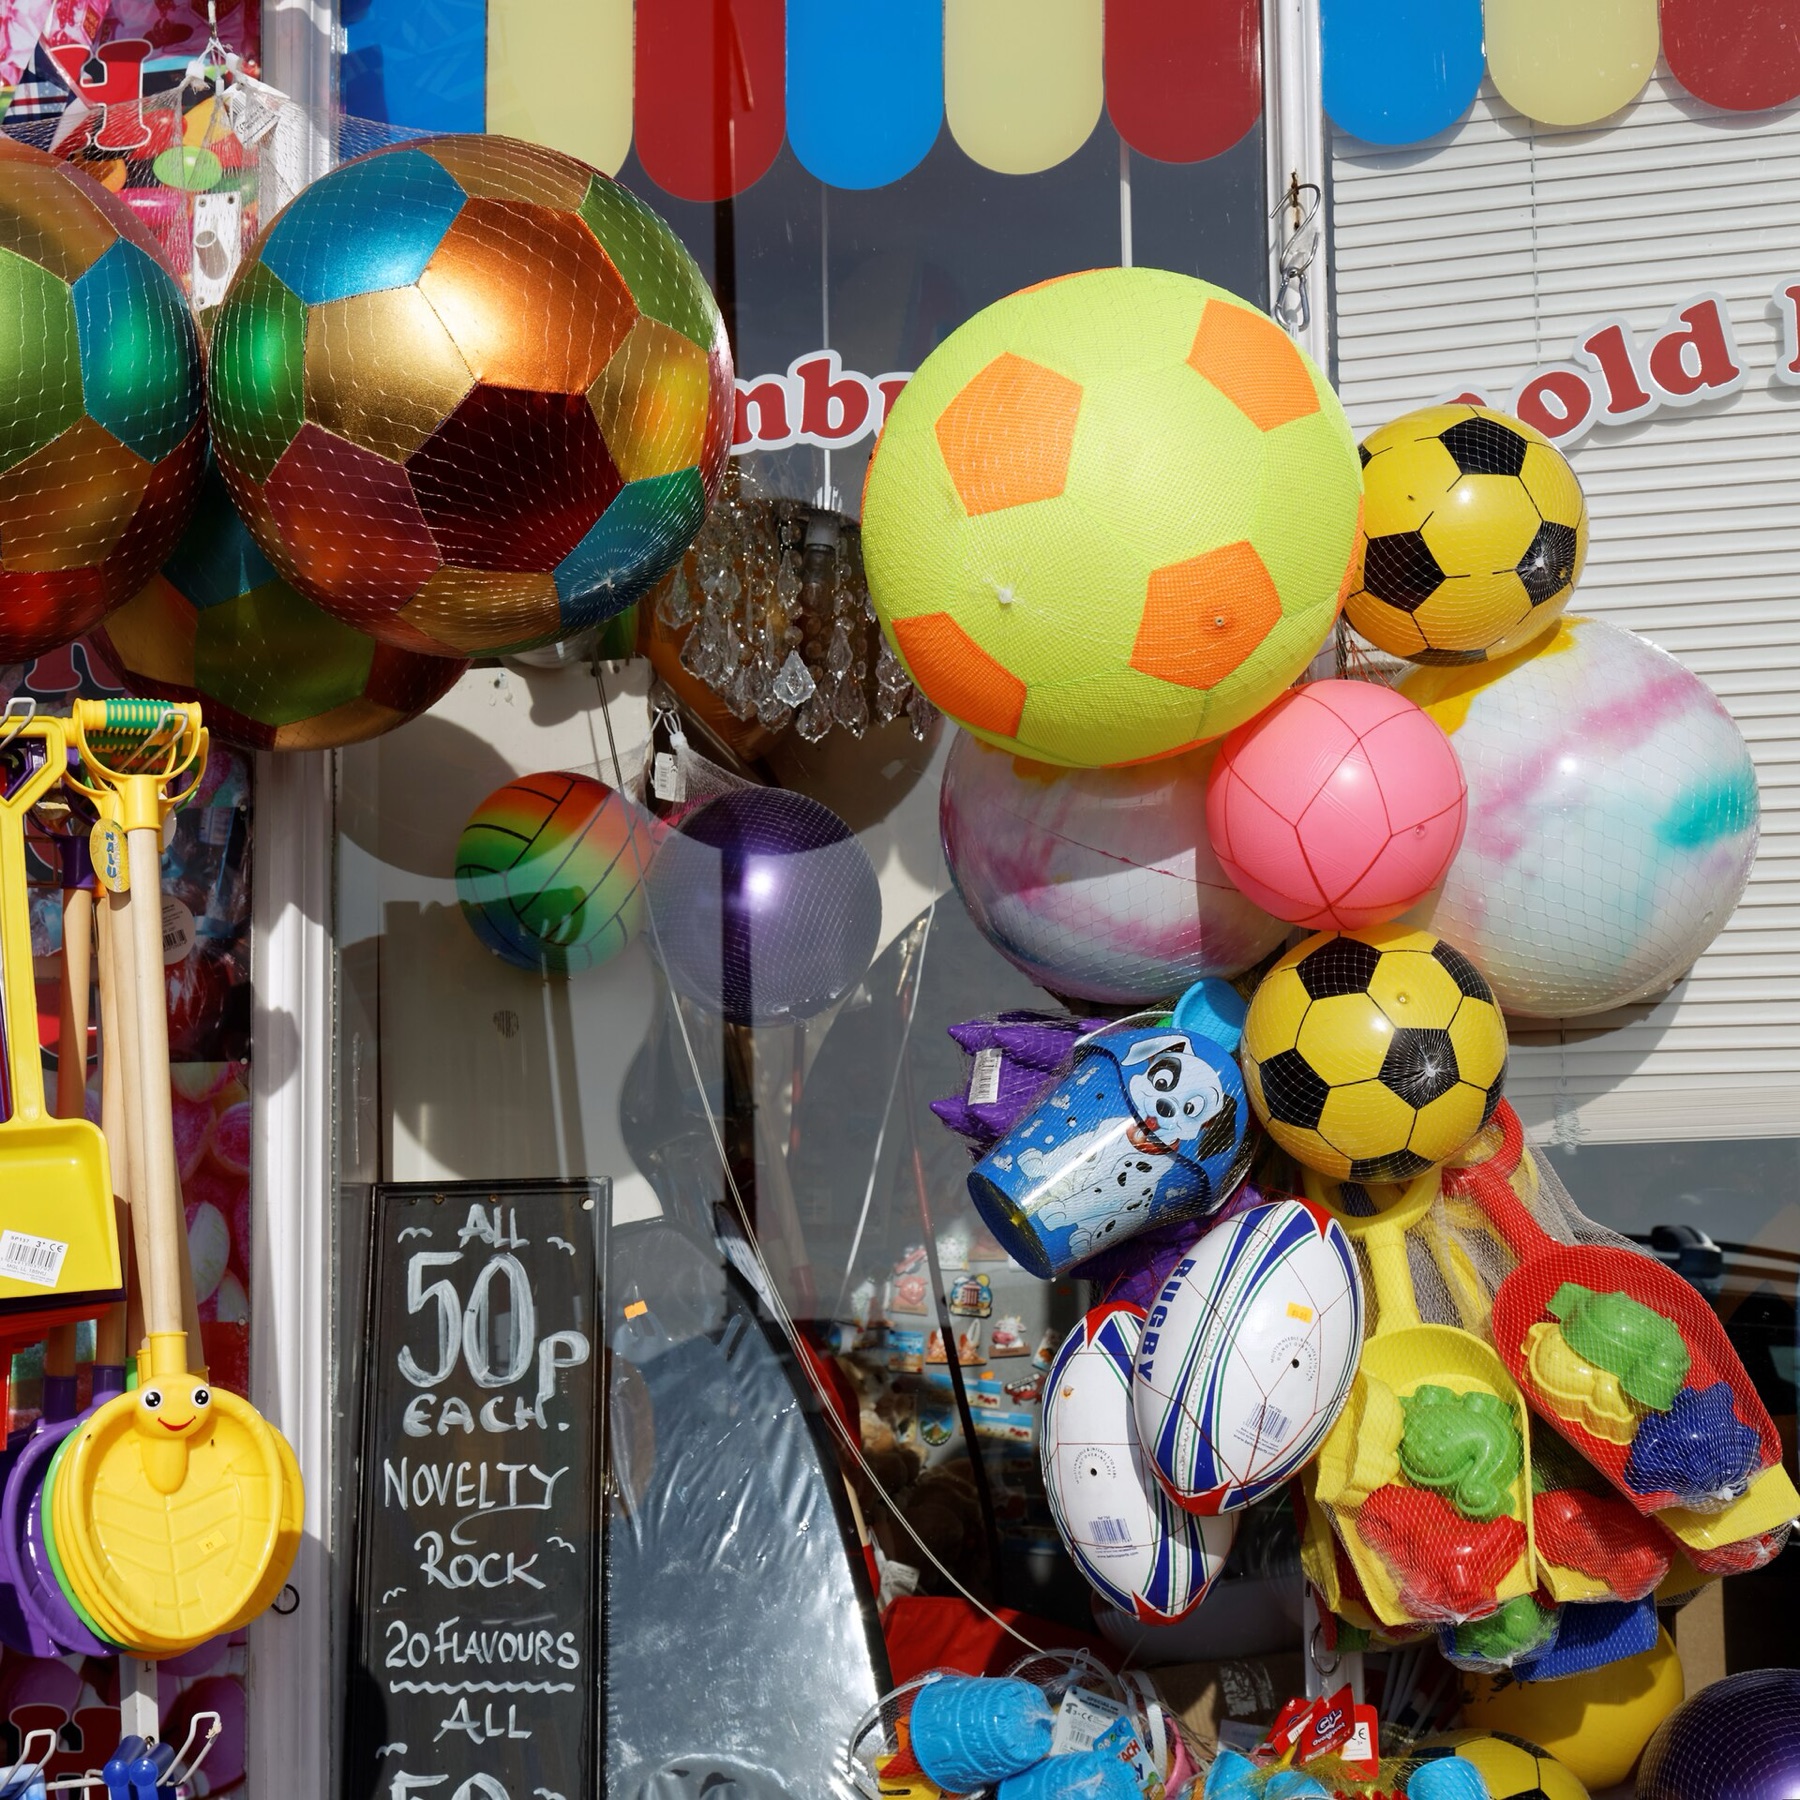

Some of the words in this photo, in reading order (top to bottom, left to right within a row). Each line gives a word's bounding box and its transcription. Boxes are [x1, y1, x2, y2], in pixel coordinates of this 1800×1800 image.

[1442, 298, 1741, 438] old
[457, 1203, 531, 1249] ALL
[1139, 1258, 1197, 1383] RUGBY
[383, 1457, 570, 1510] NOVELTY
[414, 1530, 547, 1589] ROCK
[385, 1620, 430, 1669] 20
[434, 1616, 580, 1670] FLAVOURS
[432, 1697, 532, 1744] ALL
